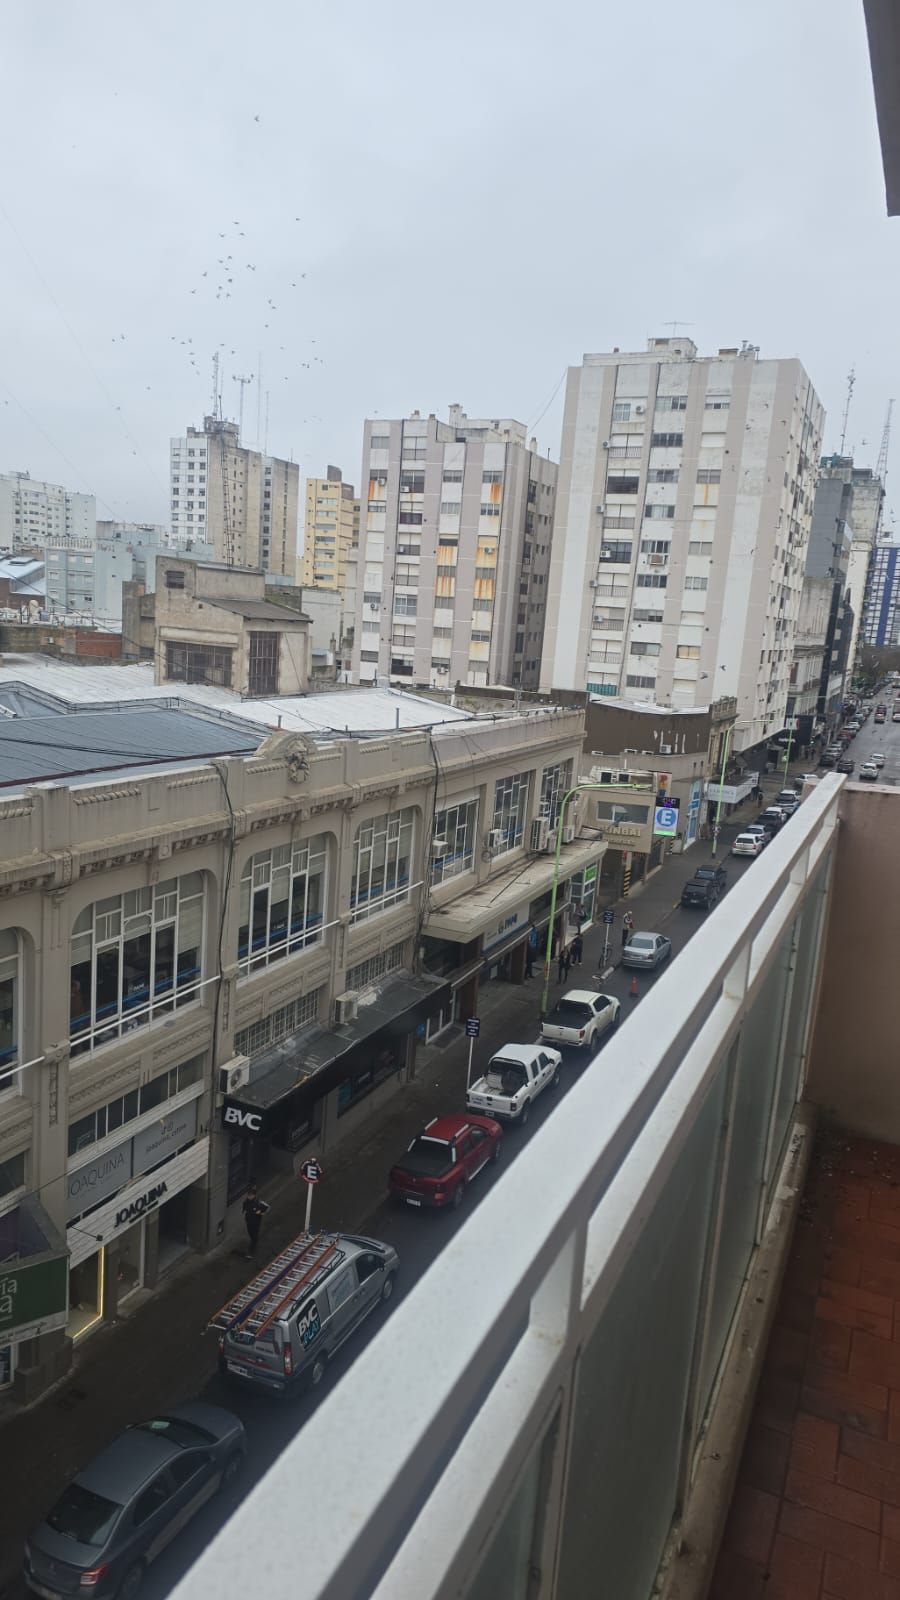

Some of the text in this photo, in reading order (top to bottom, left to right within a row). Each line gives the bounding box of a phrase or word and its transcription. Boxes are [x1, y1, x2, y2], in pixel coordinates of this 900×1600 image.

[661, 810, 671, 825] E
[224, 1107, 262, 1131] BVC
[70, 1152, 125, 1196] OAQUINA
[307, 1165, 317, 1179] E
[114, 1181, 168, 1228] JOAQUINA
[0, 1277, 18, 1294] ía
[299, 1304, 318, 1337] BVC
